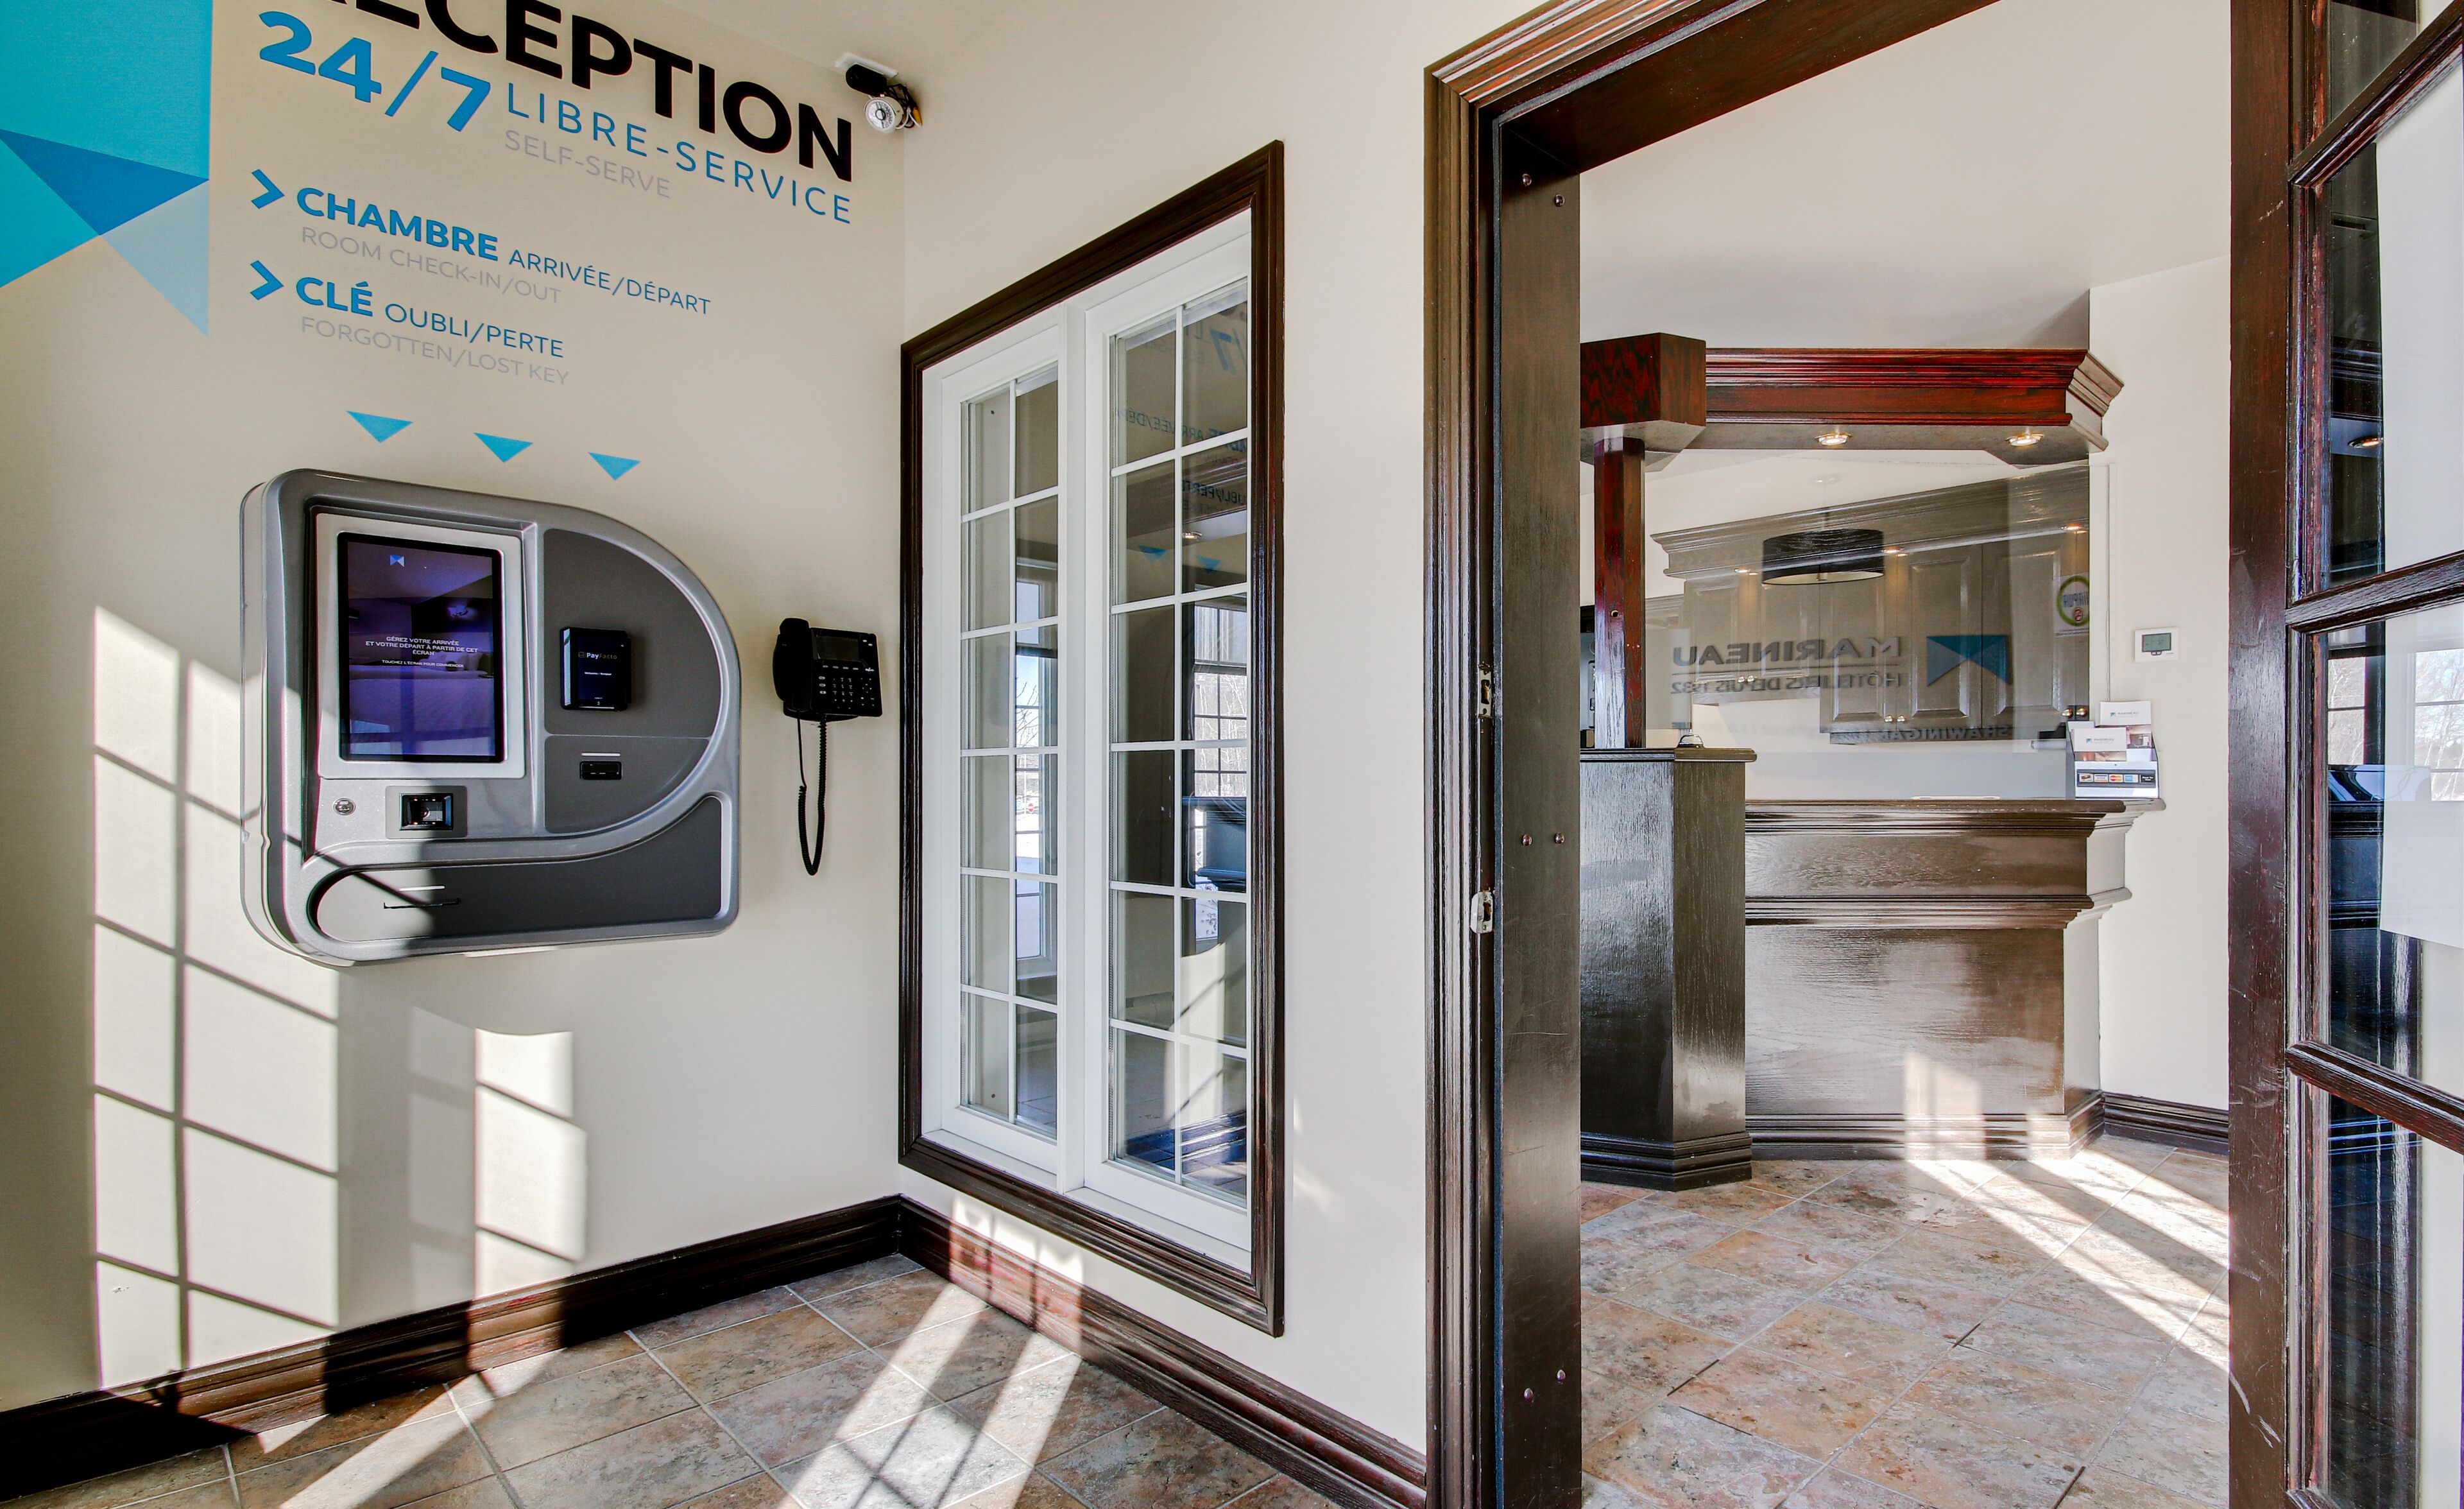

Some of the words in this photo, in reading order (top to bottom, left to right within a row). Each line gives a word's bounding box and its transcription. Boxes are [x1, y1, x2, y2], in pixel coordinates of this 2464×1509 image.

[259, 11, 491, 132] 24/7
[509, 83, 850, 224] LIBRE-SERVICE
[505, 130, 671, 198] SELF-SERVE
[296, 187, 499, 261] CHAMBRE
[509, 249, 711, 315] ARRIVÉE/DÉPART
[302, 227, 381, 261] ROOM
[389, 249, 562, 304] CHECK-IN/OUT
[296, 277, 373, 317] CLÉ
[385, 303, 563, 358] OUBLI/PERTE
[302, 316, 524, 376] FORGOTTEN/LOST
[529, 363, 569, 385] KEY
